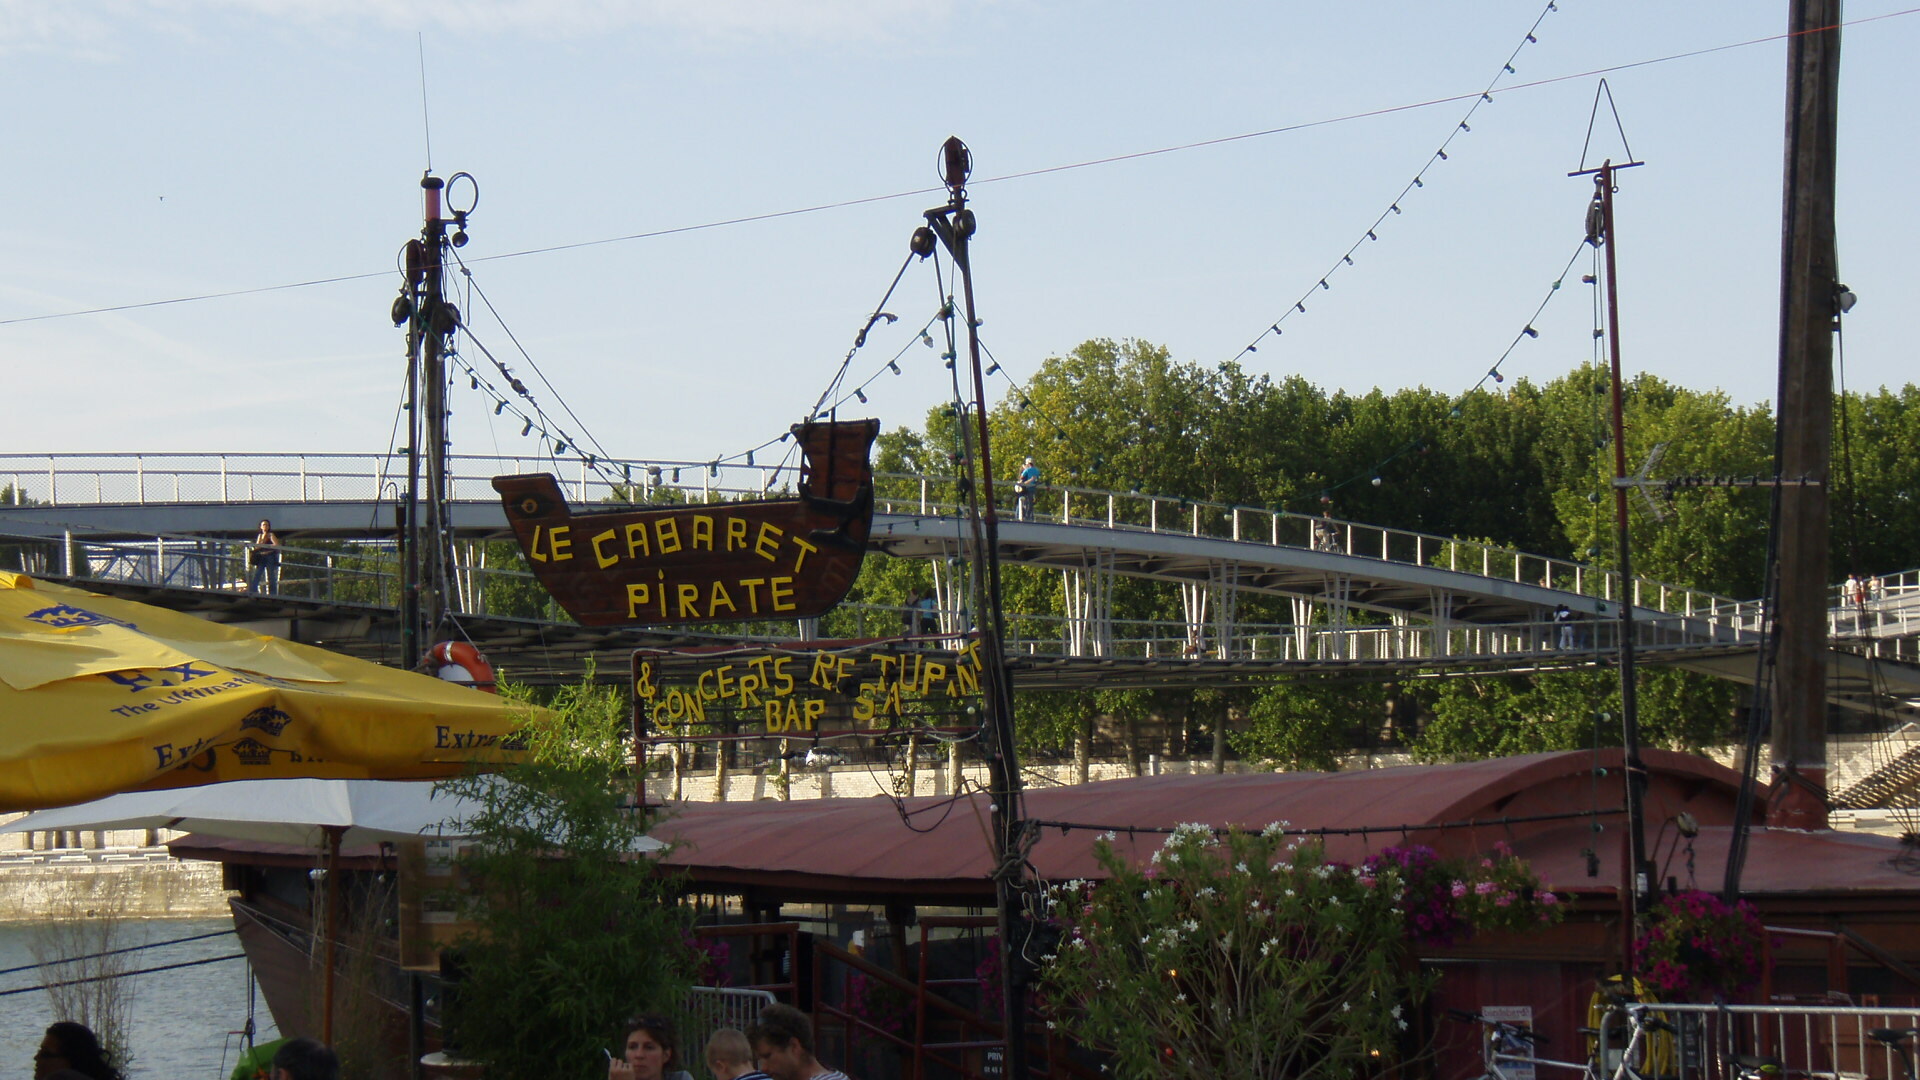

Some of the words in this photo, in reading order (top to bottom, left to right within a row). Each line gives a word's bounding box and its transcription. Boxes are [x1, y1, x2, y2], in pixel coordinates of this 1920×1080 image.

[531, 525, 573, 563] LE
[591, 515, 817, 574] CABARET
[110, 702, 161, 718] The
[637, 662, 655, 704] &
[652, 655, 794, 731] CONCERTS
[434, 725, 498, 748] Extra
